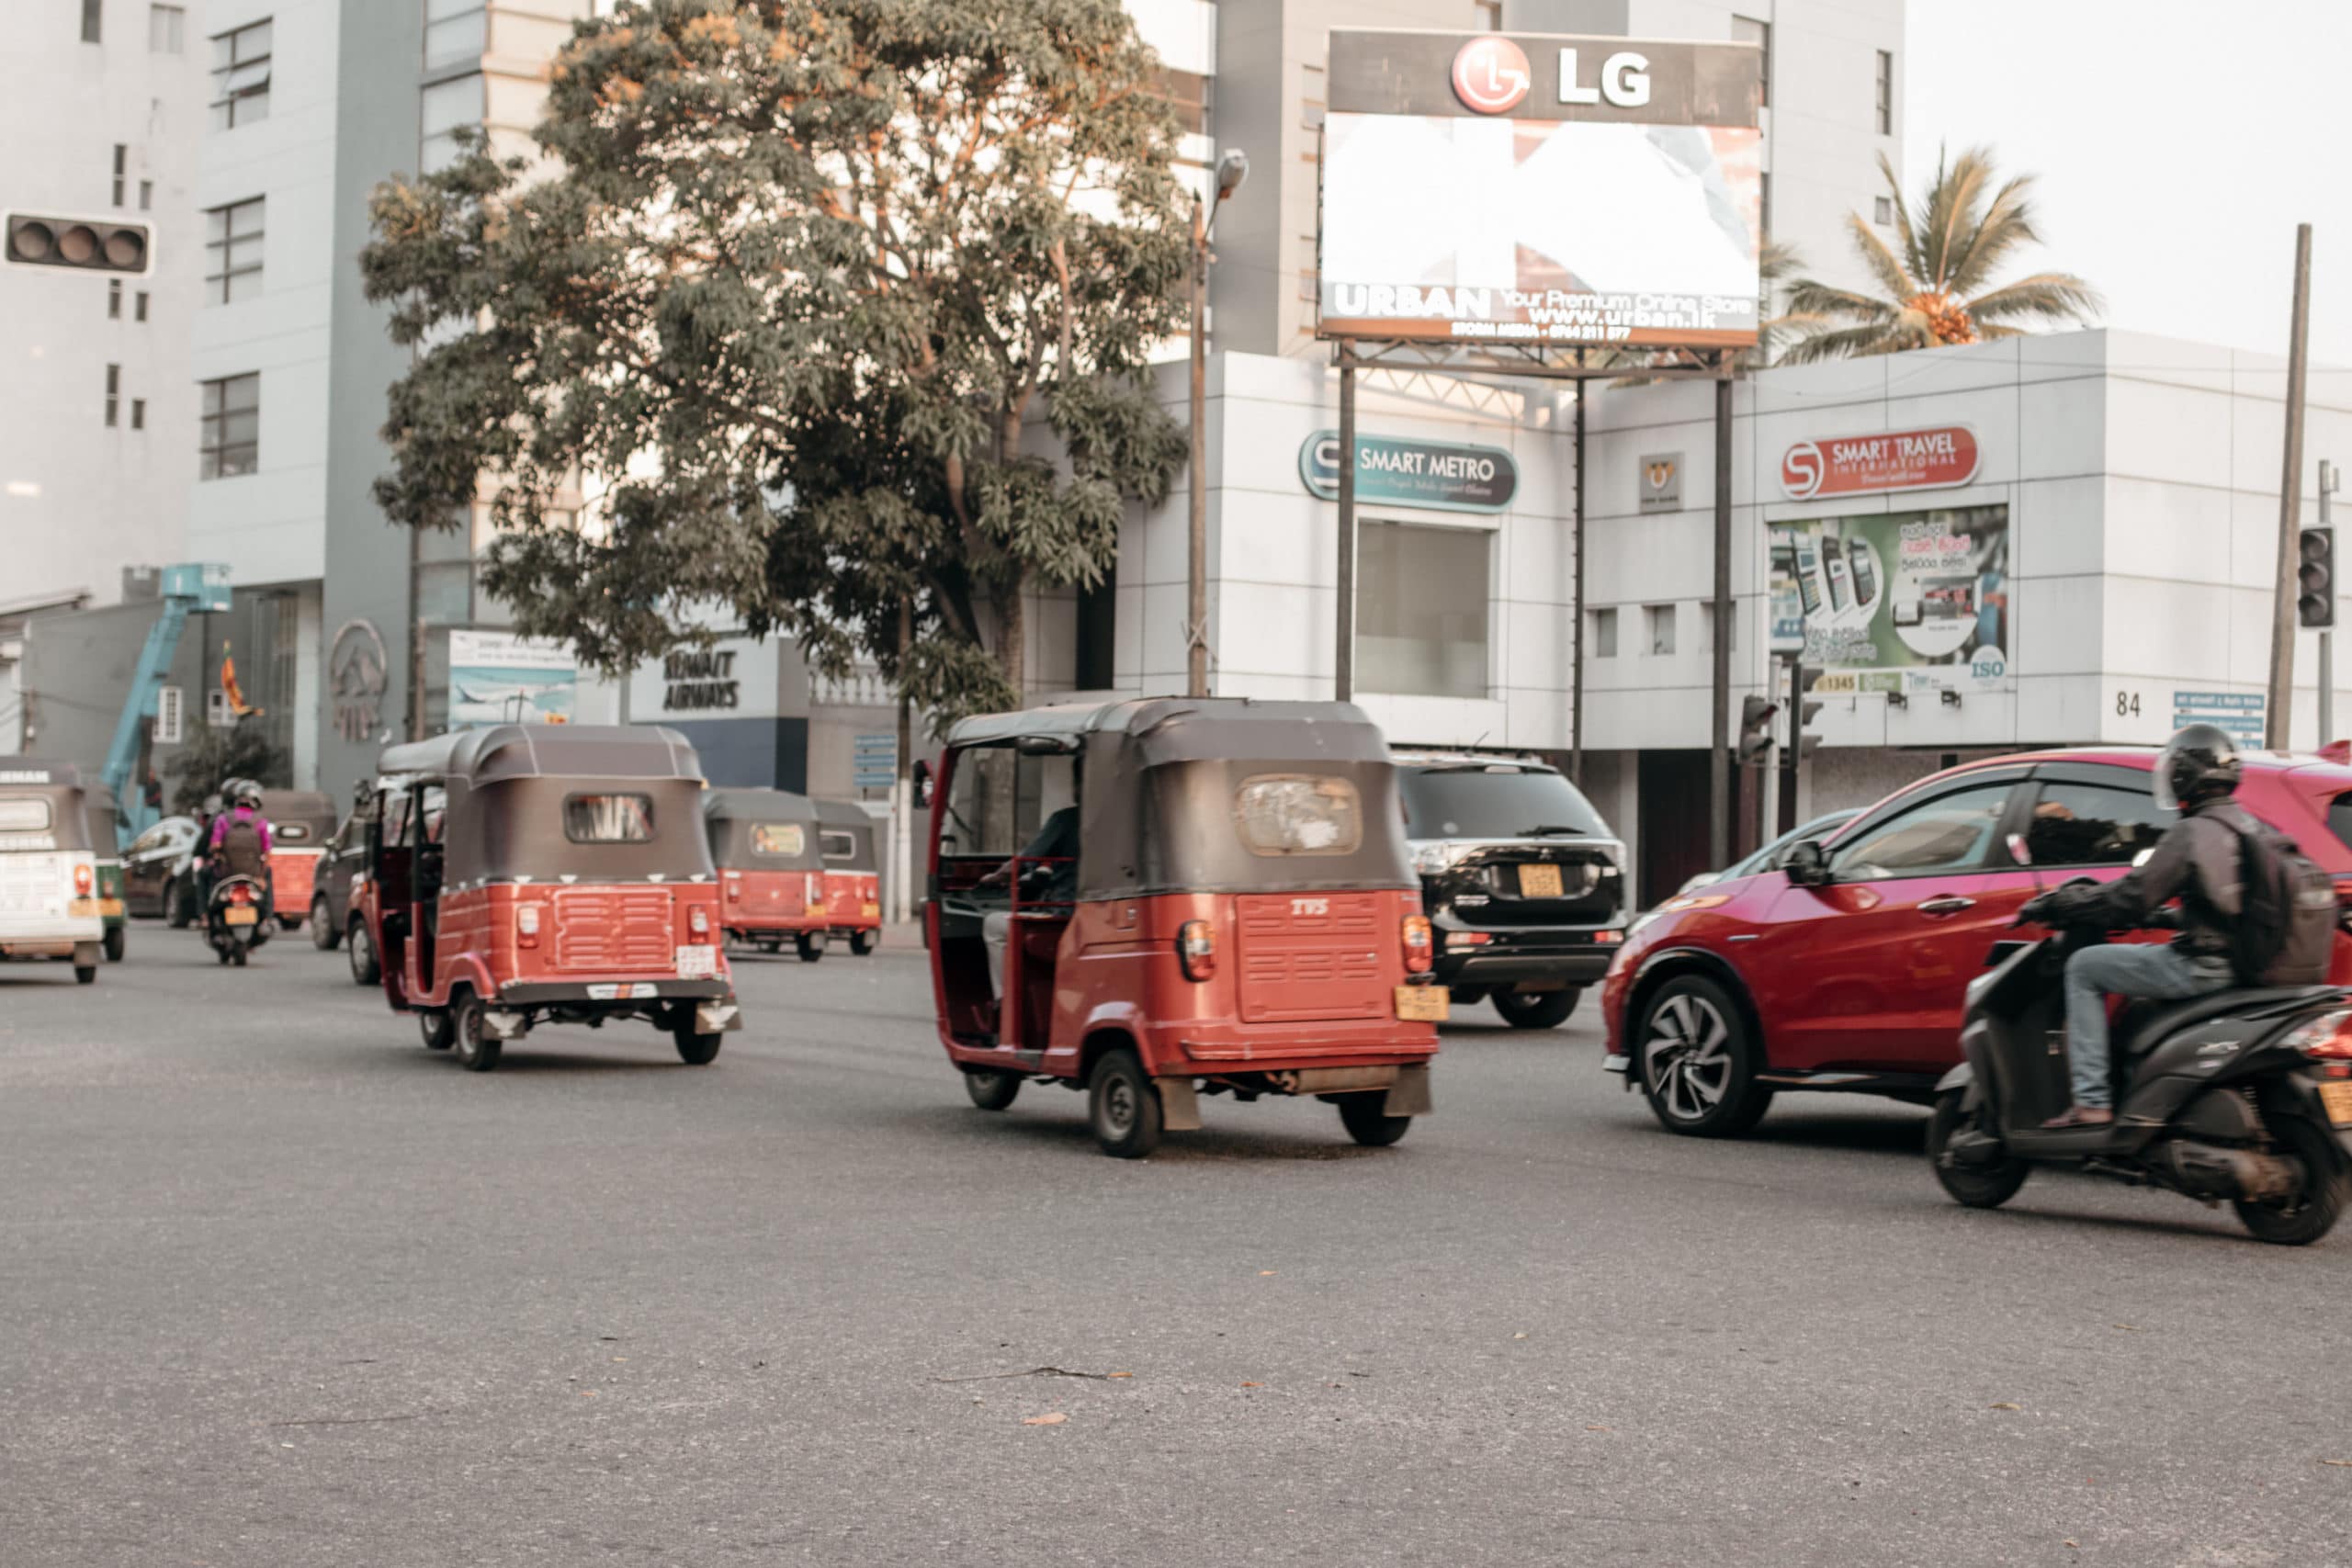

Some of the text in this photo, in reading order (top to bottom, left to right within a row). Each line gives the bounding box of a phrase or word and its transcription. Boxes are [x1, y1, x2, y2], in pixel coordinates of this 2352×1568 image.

[1559, 48, 1651, 107] LG
[1335, 284, 1491, 319] URBAN
[1500, 288, 1752, 314] Your Premium Online Store
[1528, 308, 1716, 328] www.urban.lk
[1832, 434, 1956, 464] SMART TRAVEL
[1360, 447, 1425, 475] SMART
[1429, 456, 1495, 481] METRO
[1834, 456, 1956, 474] INTERNATIONAL
[1972, 661, 2004, 678] ISO
[663, 681, 740, 710] AIRWAYS
[2116, 691, 2141, 717] 84
[1291, 898, 1329, 915] TVS
